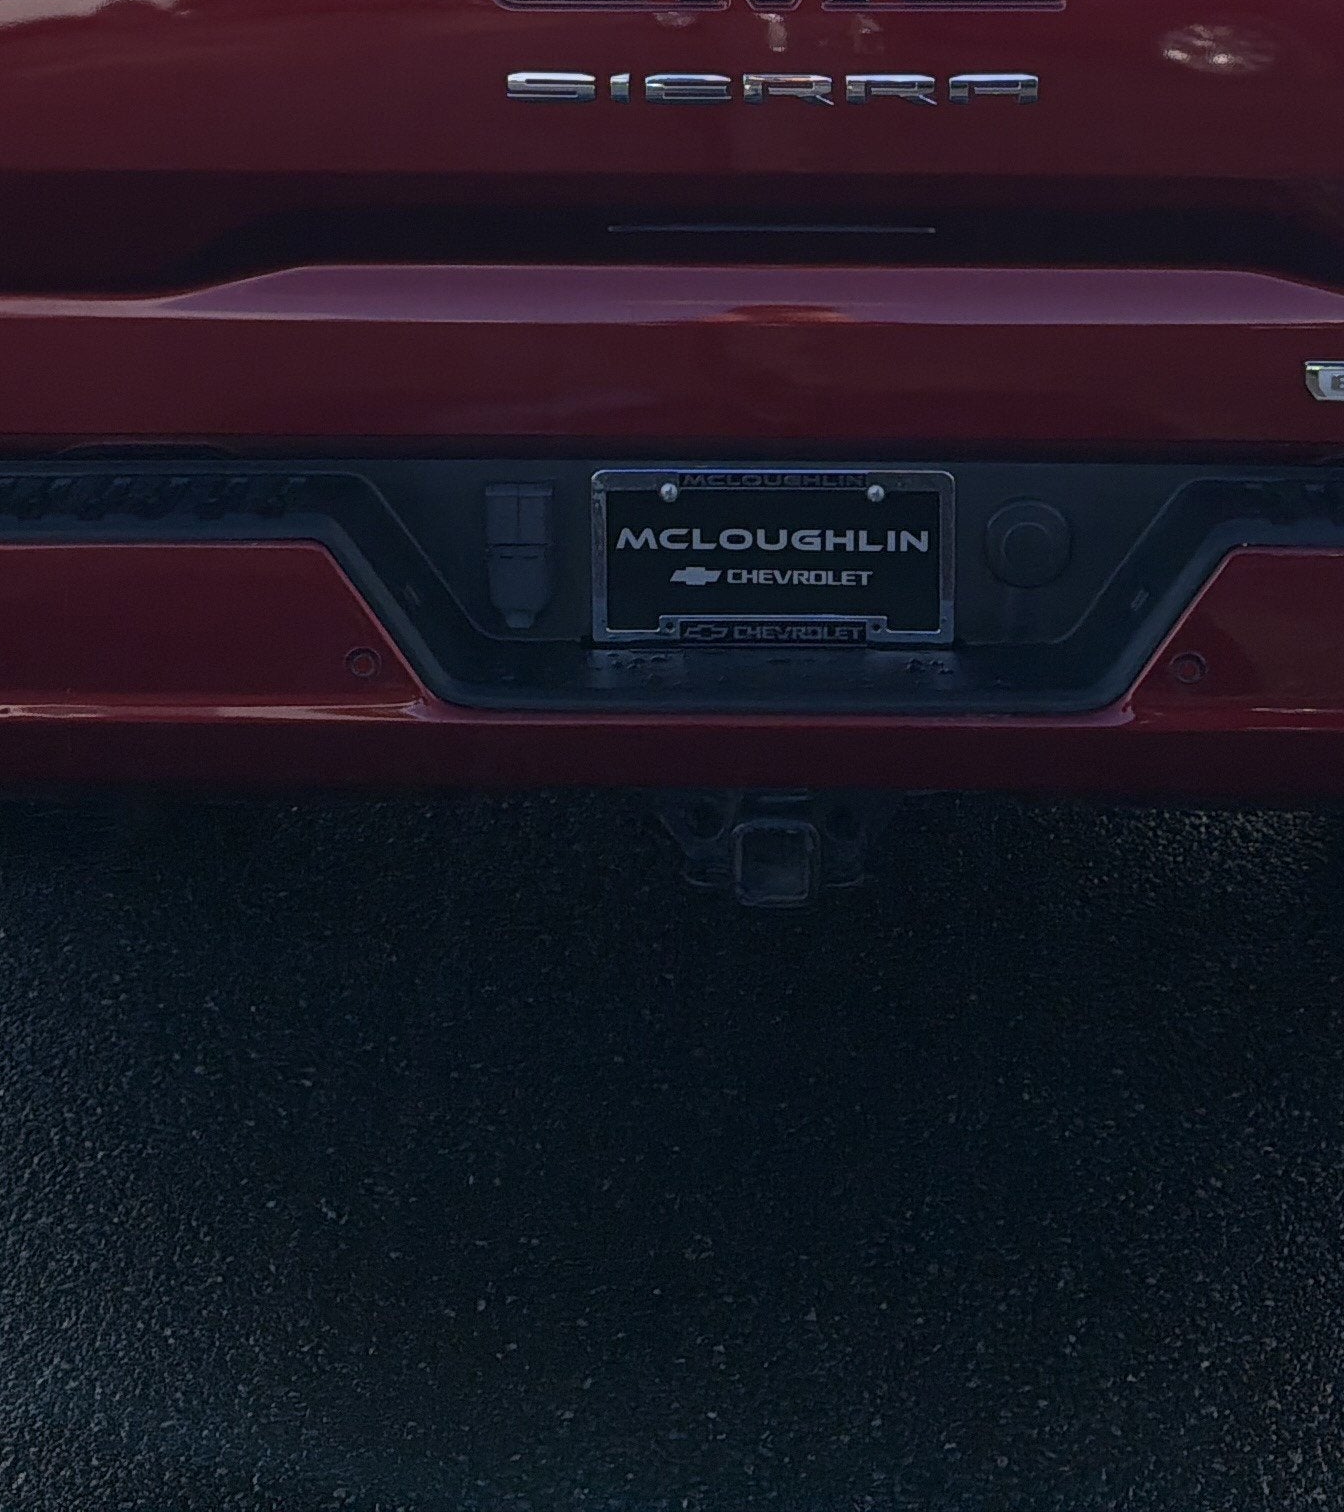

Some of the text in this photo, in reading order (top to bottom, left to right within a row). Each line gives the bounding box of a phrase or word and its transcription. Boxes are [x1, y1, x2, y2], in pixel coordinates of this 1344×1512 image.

[506, 72, 1040, 105] SIERRA
[683, 474, 864, 487] MCLOUGHLIN
[617, 528, 929, 552] MCLOUGHLIN
[726, 568, 874, 586] CHEVROLET
[732, 624, 865, 642] CHEVROLET
